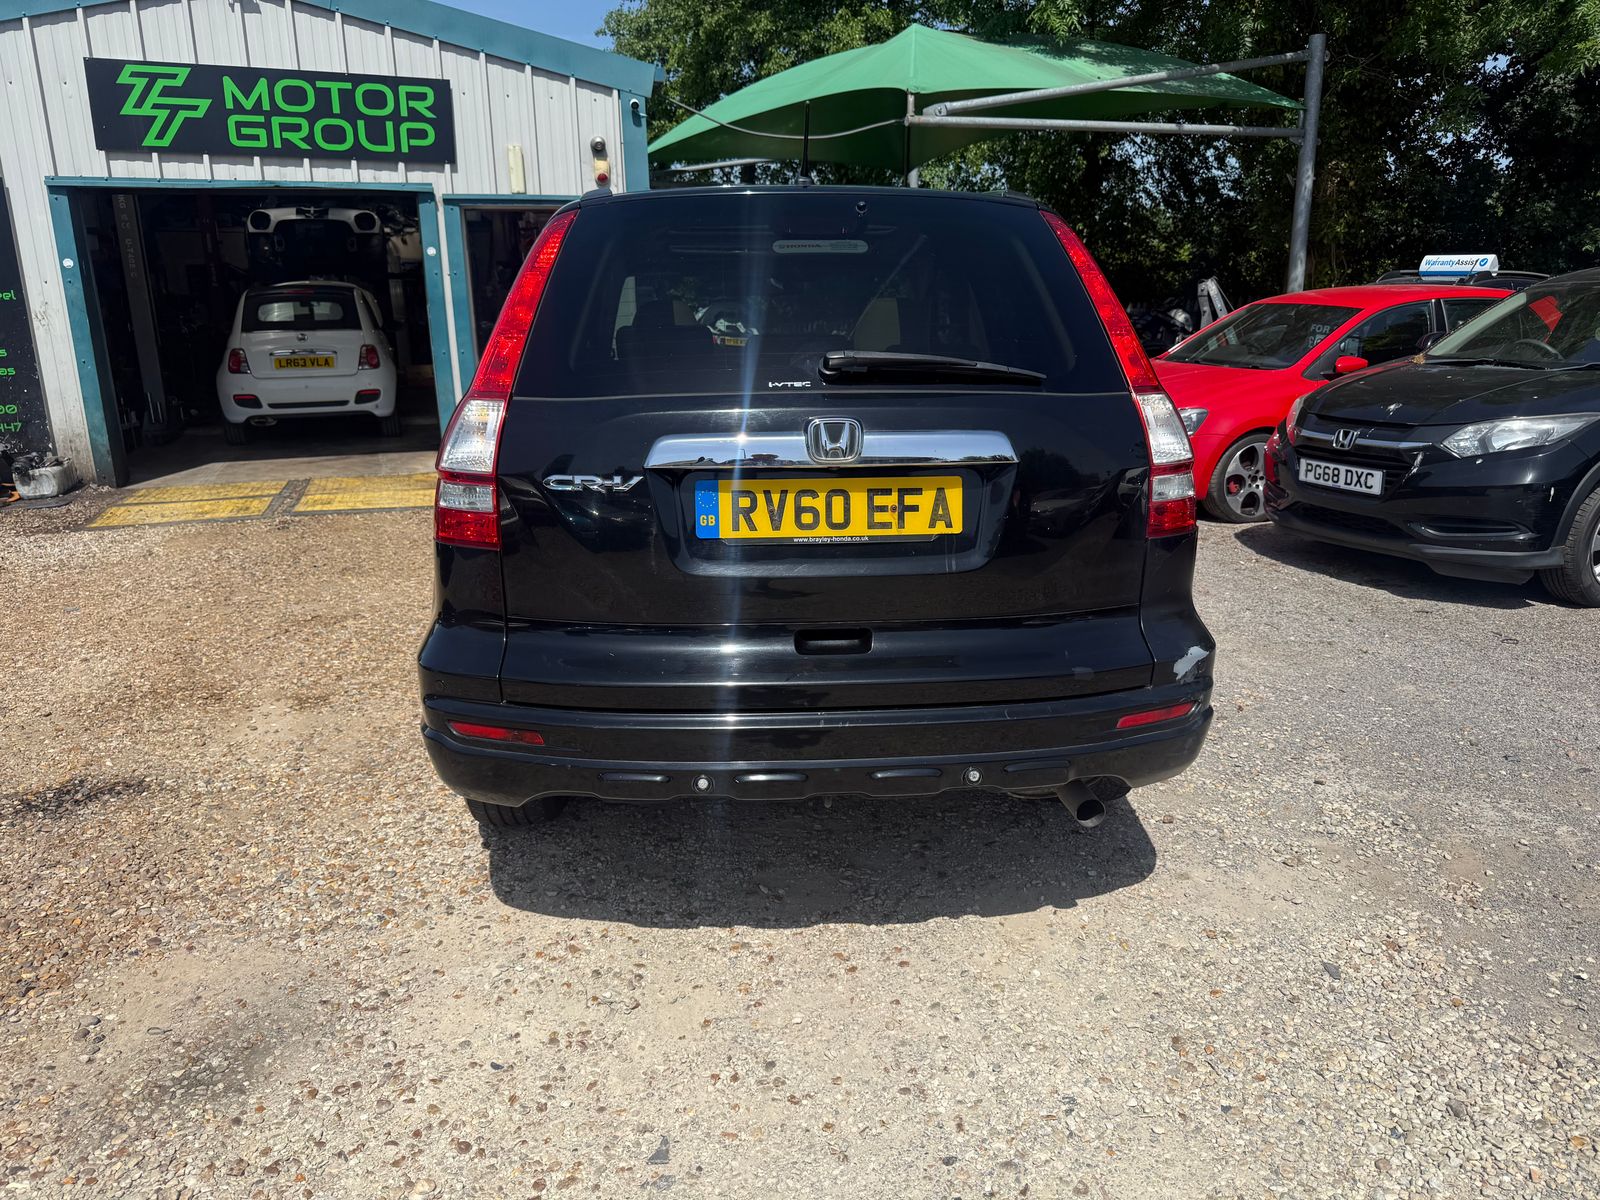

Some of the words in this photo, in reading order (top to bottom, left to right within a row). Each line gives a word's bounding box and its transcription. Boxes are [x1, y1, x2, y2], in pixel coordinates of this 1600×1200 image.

[222, 76, 437, 118] MOTOR
[227, 114, 436, 153] GROUP
[0, 290, 17, 300] el
[1310, 323, 1331, 334] FOR
[279, 357, 307, 369] LR63
[309, 356, 330, 368] VLA
[1304, 462, 1340, 484] PG68
[1344, 468, 1375, 489] DXC
[542, 474, 644, 494] CR-V
[731, 488, 852, 532] RV60
[866, 487, 954, 530] EFA
[699, 514, 716, 527] GB
[793, 535, 869, 544] www.brayley-honda.co.uk
